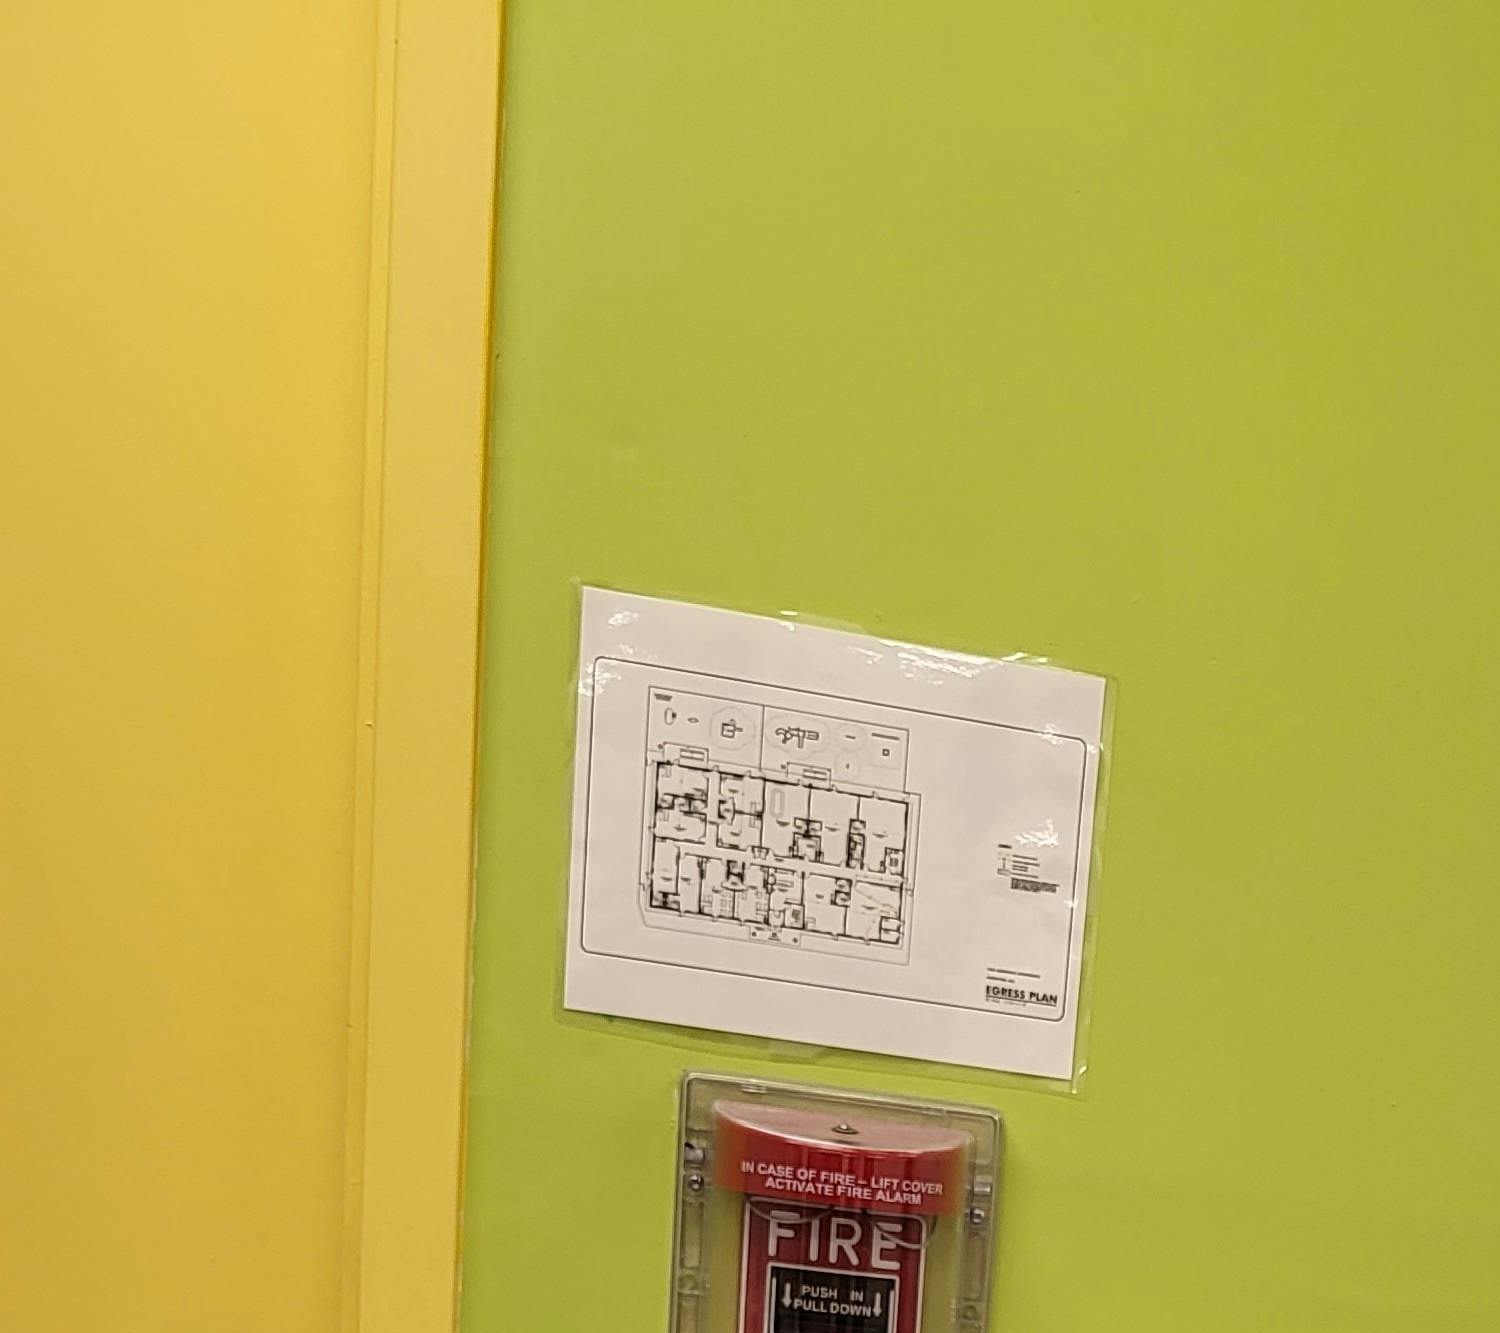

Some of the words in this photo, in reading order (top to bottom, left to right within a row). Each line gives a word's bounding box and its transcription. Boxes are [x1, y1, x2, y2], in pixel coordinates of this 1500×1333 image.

[986, 984, 1026, 1000] EGRESS
[1029, 990, 1058, 1005] PLAN
[741, 1160, 755, 1174] IN
[757, 1163, 795, 1180] CASE
[796, 1167, 817, 1181] OF
[819, 1170, 856, 1187] FIRE
[871, 1177, 900, 1192] LIFT
[901, 1180, 944, 1196] COVER
[765, 1178, 834, 1197] ACTIVATE
[836, 1184, 873, 1201] FIRE
[875, 1190, 922, 1206] ALARM
[768, 1209, 903, 1271] FIRE
[801, 1285, 838, 1300] PUSH
[850, 1289, 864, 1303] IN
[794, 1299, 827, 1314] PULL
[829, 1301, 872, 1318] DOWN
